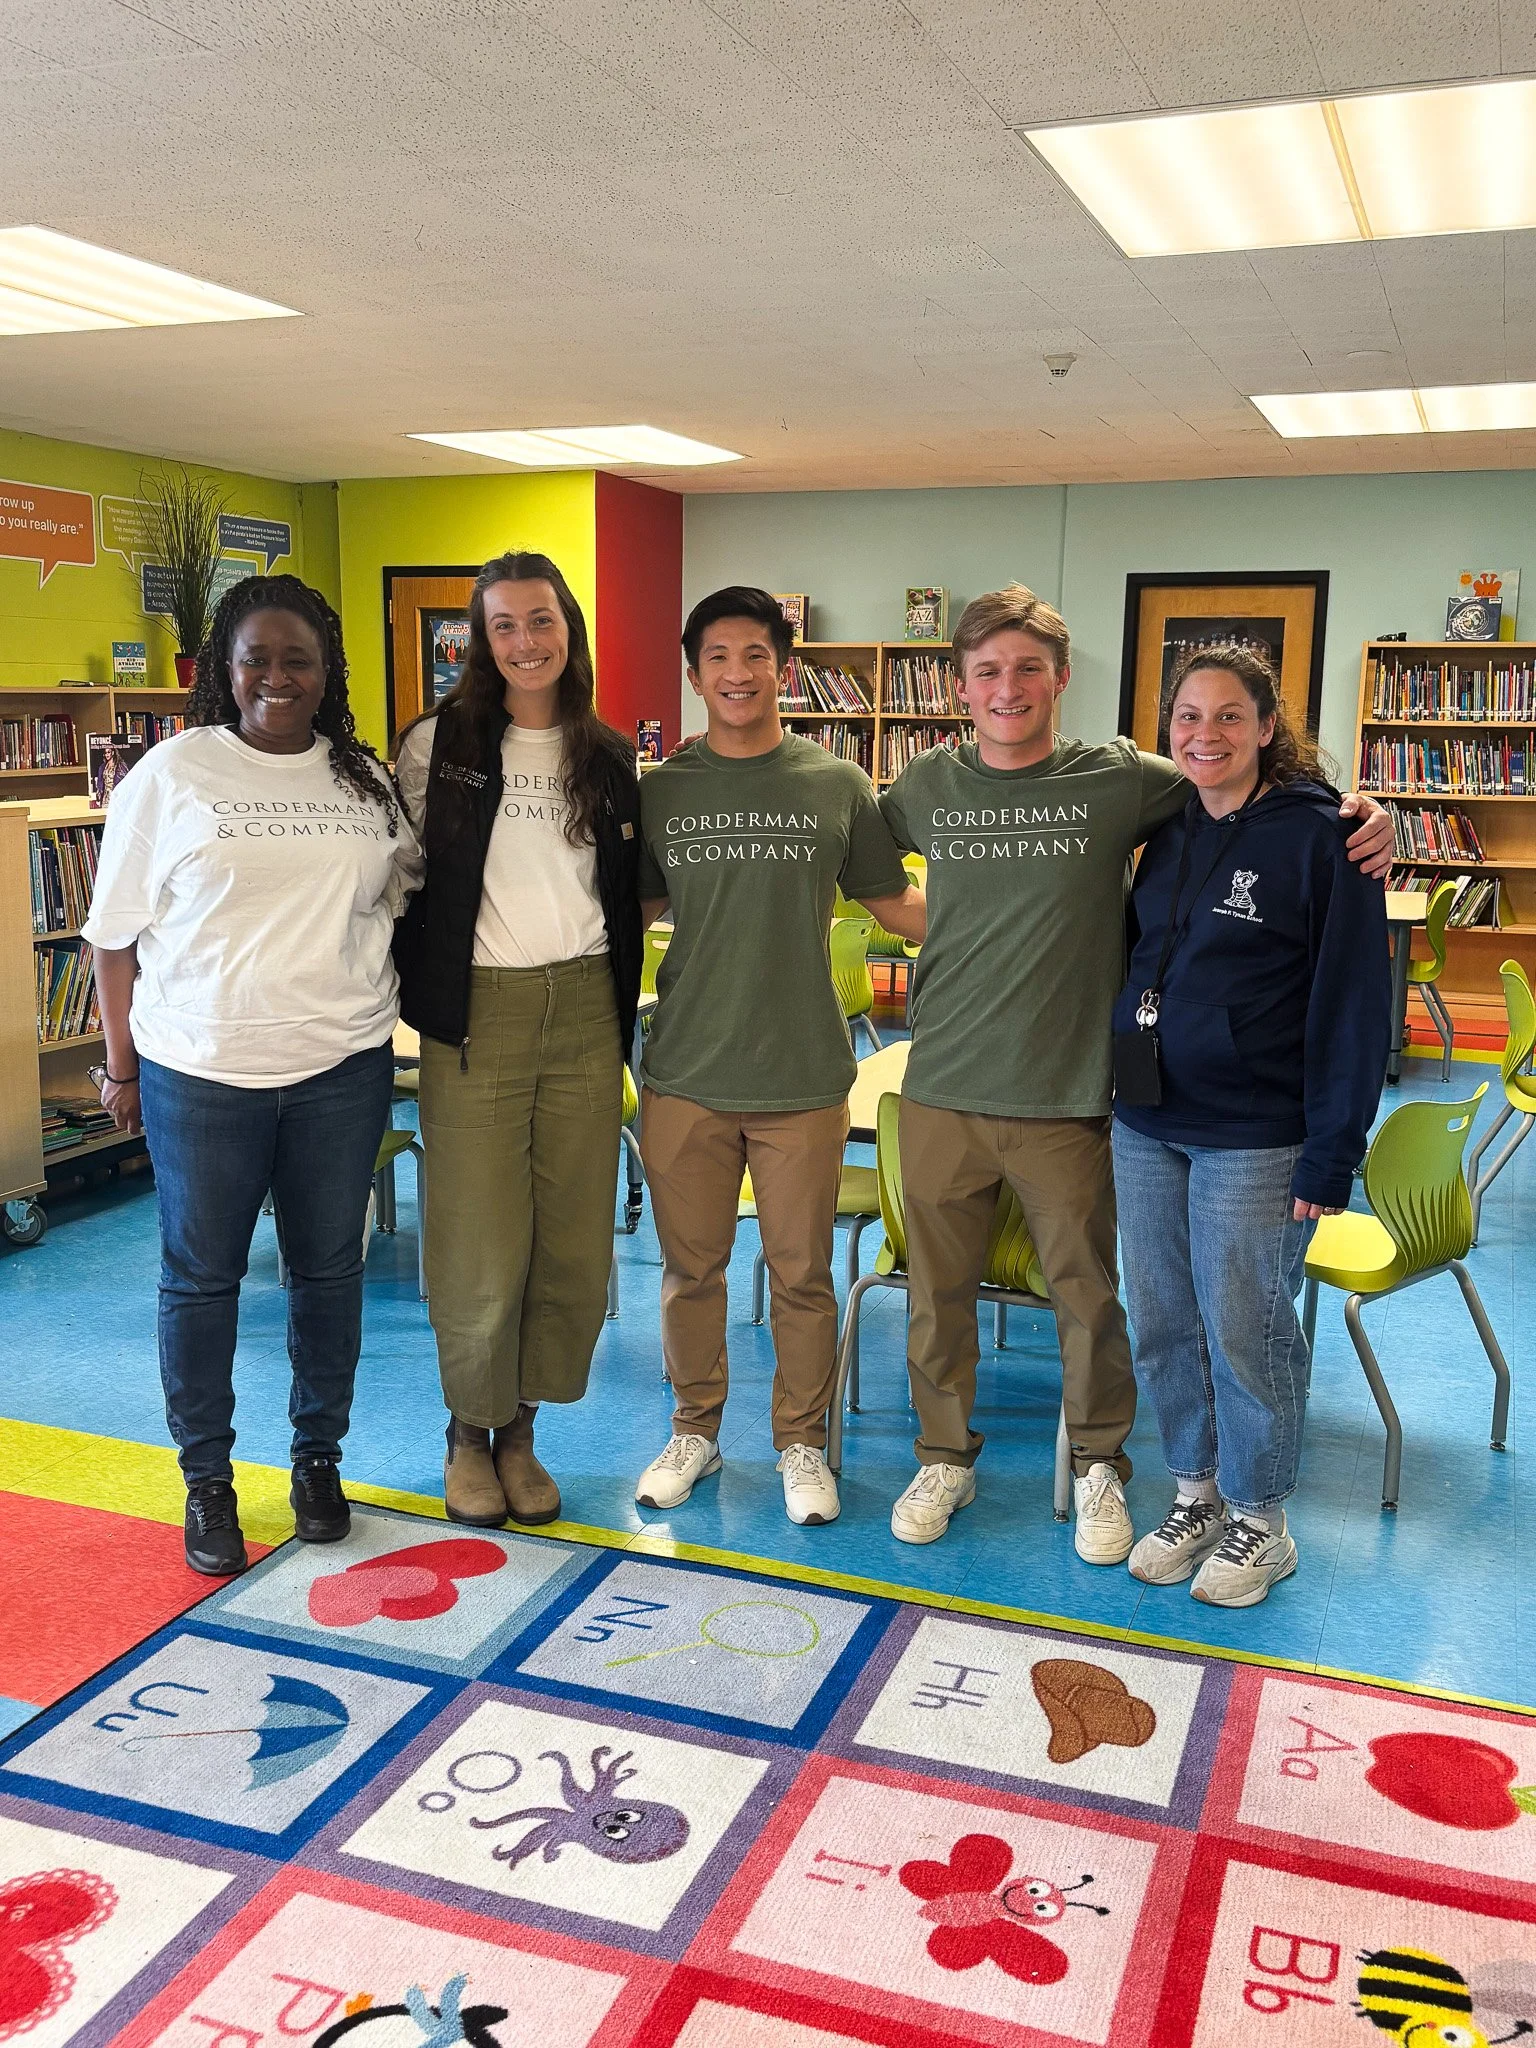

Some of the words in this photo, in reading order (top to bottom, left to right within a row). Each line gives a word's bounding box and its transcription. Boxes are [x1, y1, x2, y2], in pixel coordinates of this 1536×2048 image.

[21, 500, 35, 513] up
[8, 517, 28, 529] you
[30, 519, 58, 535] really
[213, 801, 375, 818] CORDERMAN
[932, 803, 1088, 827] CORDERMAN
[217, 824, 238, 839] &
[245, 822, 380, 841] COMPANY
[666, 812, 818, 835] CORDERMAN
[667, 848, 682, 868] &
[686, 843, 817, 863] COMPANY
[930, 841, 944, 860] &
[949, 837, 1089, 859] COMPANY
[573, 1595, 670, 1643] Nn
[908, 1660, 1000, 1710] Hh
[91, 1681, 210, 1733] Uu
[1280, 1716, 1358, 1781] Aa
[417, 1750, 523, 1813] Oo
[805, 1848, 893, 1891] Ii
[1243, 1925, 1340, 2014] Bb
